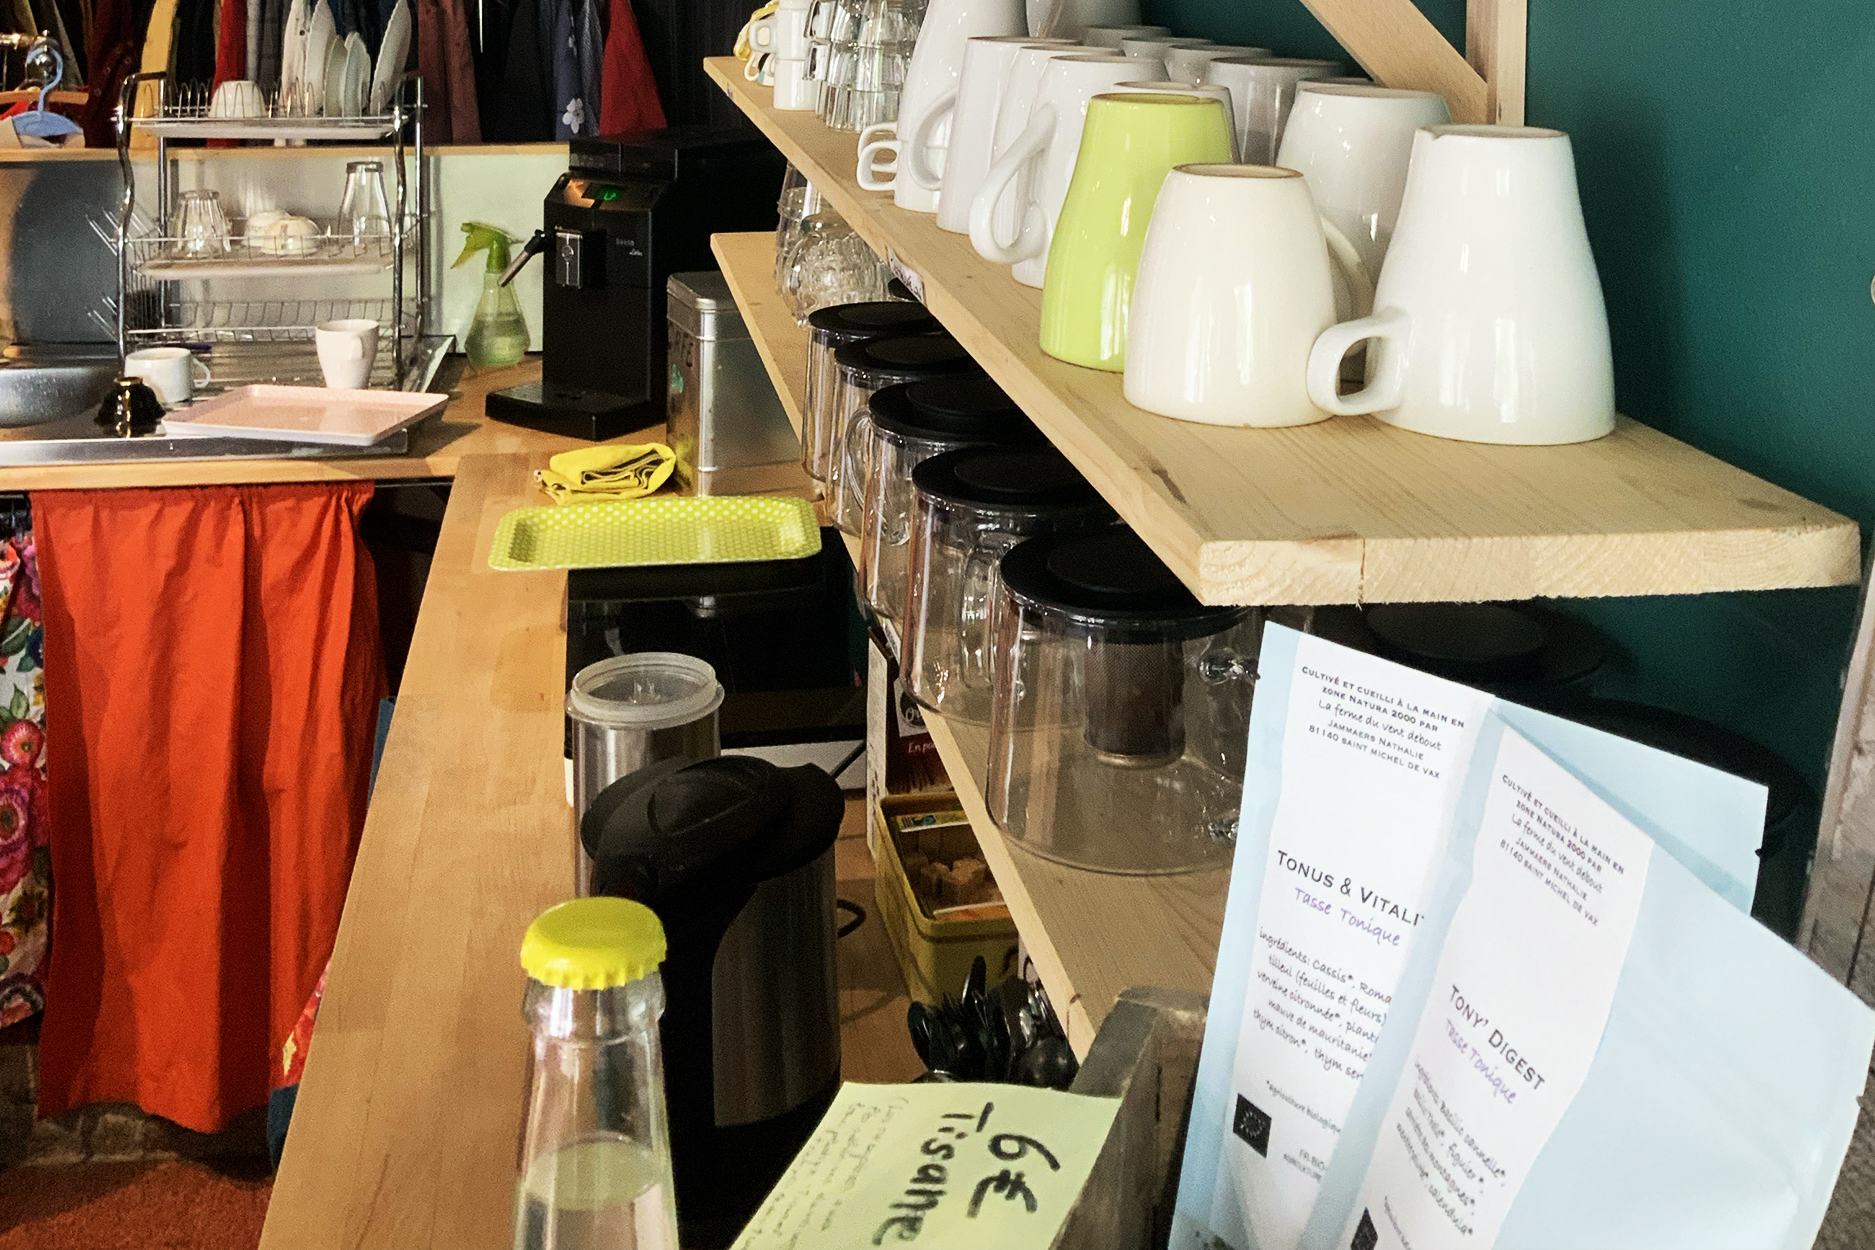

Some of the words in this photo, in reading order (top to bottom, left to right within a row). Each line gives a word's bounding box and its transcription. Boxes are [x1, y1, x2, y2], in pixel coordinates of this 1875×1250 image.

[1318, 699, 1331, 711] La
[1334, 702, 1363, 723] ferme
[1365, 715, 1379, 728] du
[1382, 723, 1404, 738] vent
[1408, 731, 1442, 751] debout
[1322, 686, 1346, 700] ZONE
[1391, 710, 1416, 724] 2000
[1419, 720, 1438, 732] PAR
[1423, 708, 1448, 723] MAIN
[1451, 718, 1465, 728] EN
[1309, 724, 1339, 741] 81140
[1341, 738, 1368, 752] SAINT
[1371, 747, 1405, 766] MICHEL
[1408, 761, 1420, 771] DE
[1423, 767, 1440, 779] VAX
[1379, 737, 1424, 760] NATHALIE
[1278, 850, 1335, 888] TONUS
[1340, 877, 1351, 897] &
[1567, 840, 1585, 860] 2000
[1295, 887, 1332, 915] Tasse
[1340, 908, 1400, 946] Tonique
[1268, 999, 1294, 1022] mauve
[1296, 1015, 1307, 1028] de
[1338, 995, 1348, 1006] et
[1254, 1009, 1274, 1031] thym
[1314, 1048, 1343, 1071] thym
[1446, 1017, 1468, 1054] Tasse
[1470, 1047, 1517, 1104] Tonique
[1488, 1029, 1545, 1090] DIGEST
[872, 1101, 994, 1246] Tisane
